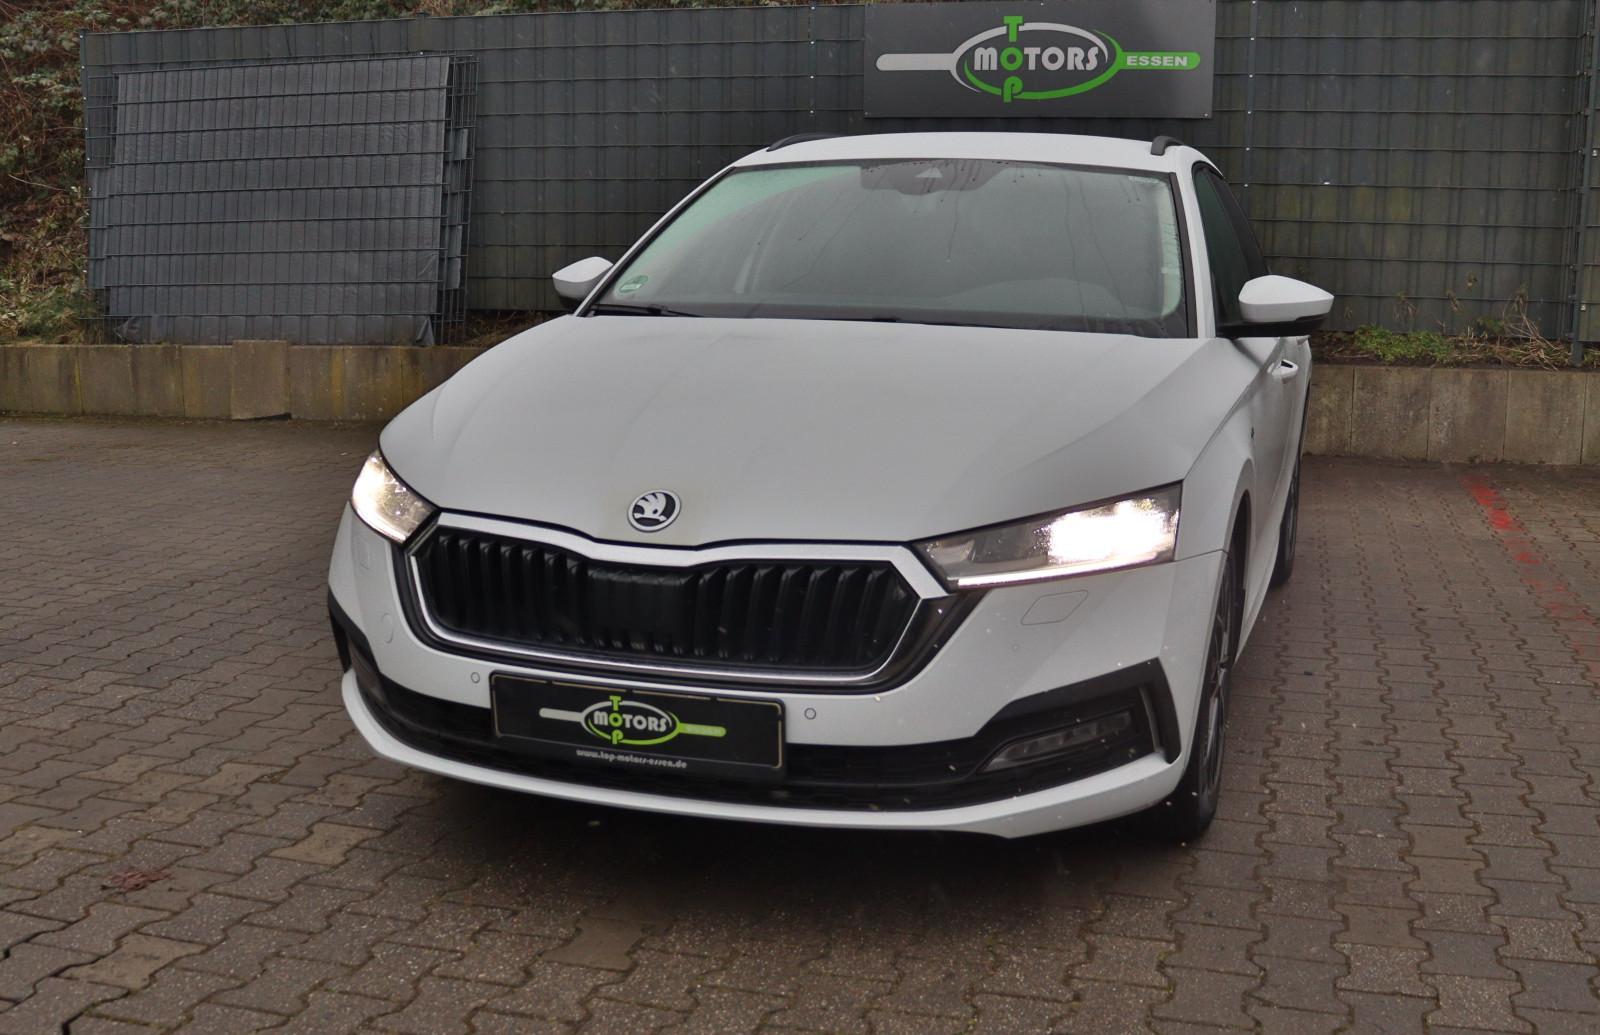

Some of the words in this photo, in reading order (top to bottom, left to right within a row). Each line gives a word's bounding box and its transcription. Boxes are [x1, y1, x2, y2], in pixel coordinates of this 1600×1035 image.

[974, 46, 1101, 72] MOTORS
[1126, 55, 1189, 67] ESSEN
[1003, 15, 1024, 103] TOP
[593, 711, 668, 733] MOTORS
[609, 695, 625, 745] TOP
[576, 749, 688, 769] www.top-motors-essen.de
